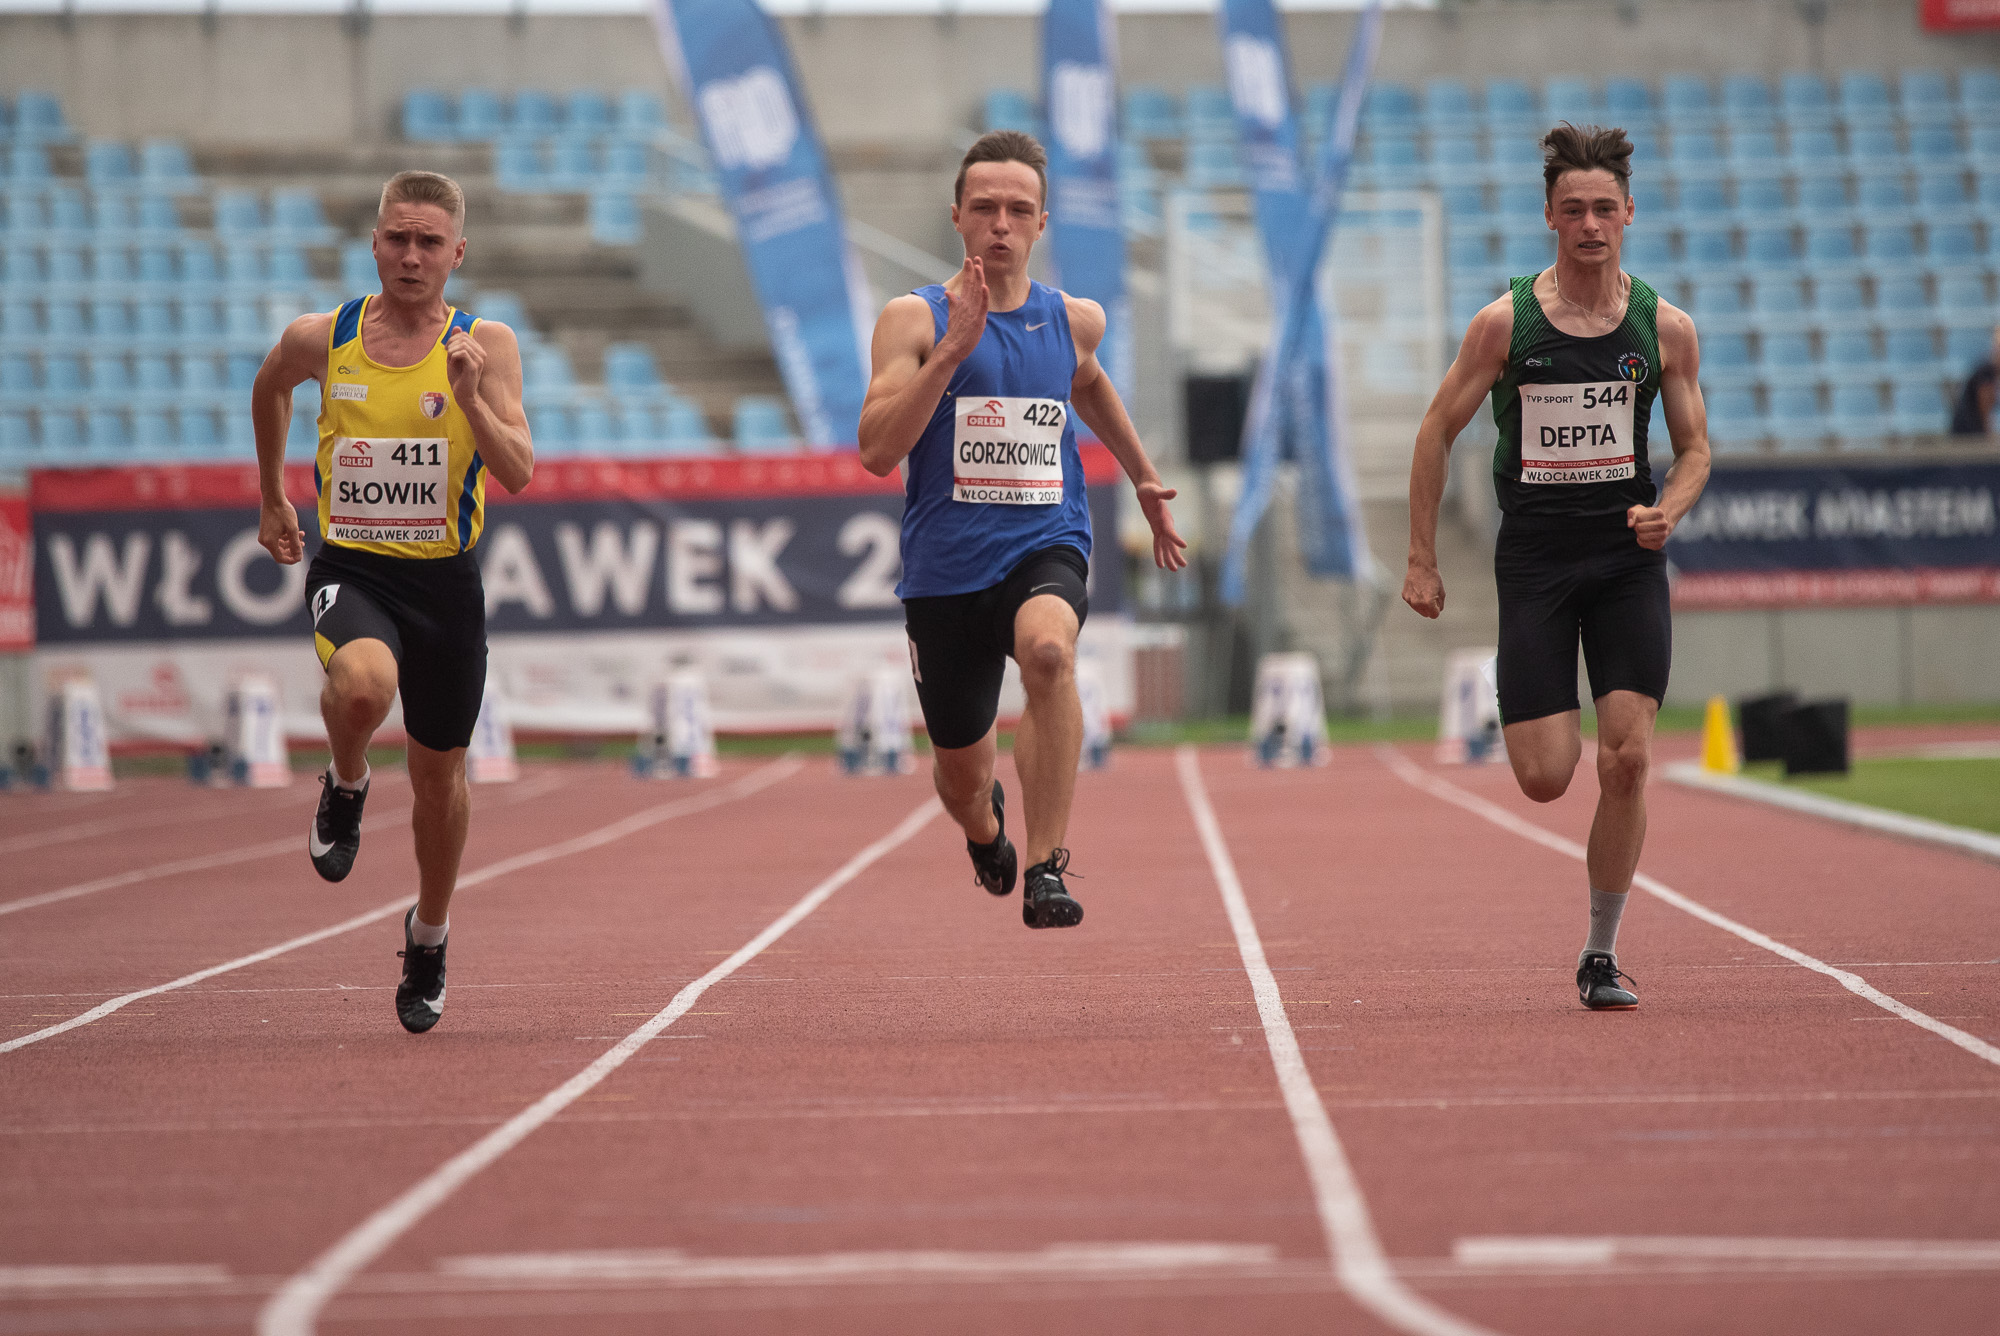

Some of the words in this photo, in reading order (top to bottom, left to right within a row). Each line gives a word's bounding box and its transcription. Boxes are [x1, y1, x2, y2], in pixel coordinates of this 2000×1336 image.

[1526, 395, 1542, 403] TVP
[1544, 396, 1574, 404] SPORT
[1582, 385, 1628, 409] 544
[969, 417, 1003, 426] ORLEN
[1023, 403, 1062, 427] 422
[1540, 424, 1617, 448] DEPTA
[340, 457, 371, 466] ORLEN
[391, 443, 441, 466] 411
[960, 440, 1057, 466] GORZKOWICZ
[1527, 469, 1602, 482] WŁOCŁAWEK
[1606, 467, 1629, 479] 2021
[339, 481, 437, 505] SŁOWIK
[960, 489, 1037, 502] WŁOCŁAWEK
[1038, 491, 1060, 502] 2021
[335, 527, 410, 540] WŁOCŁAWEK
[413, 529, 440, 540] 2021
[317, 589, 330, 618] 4
